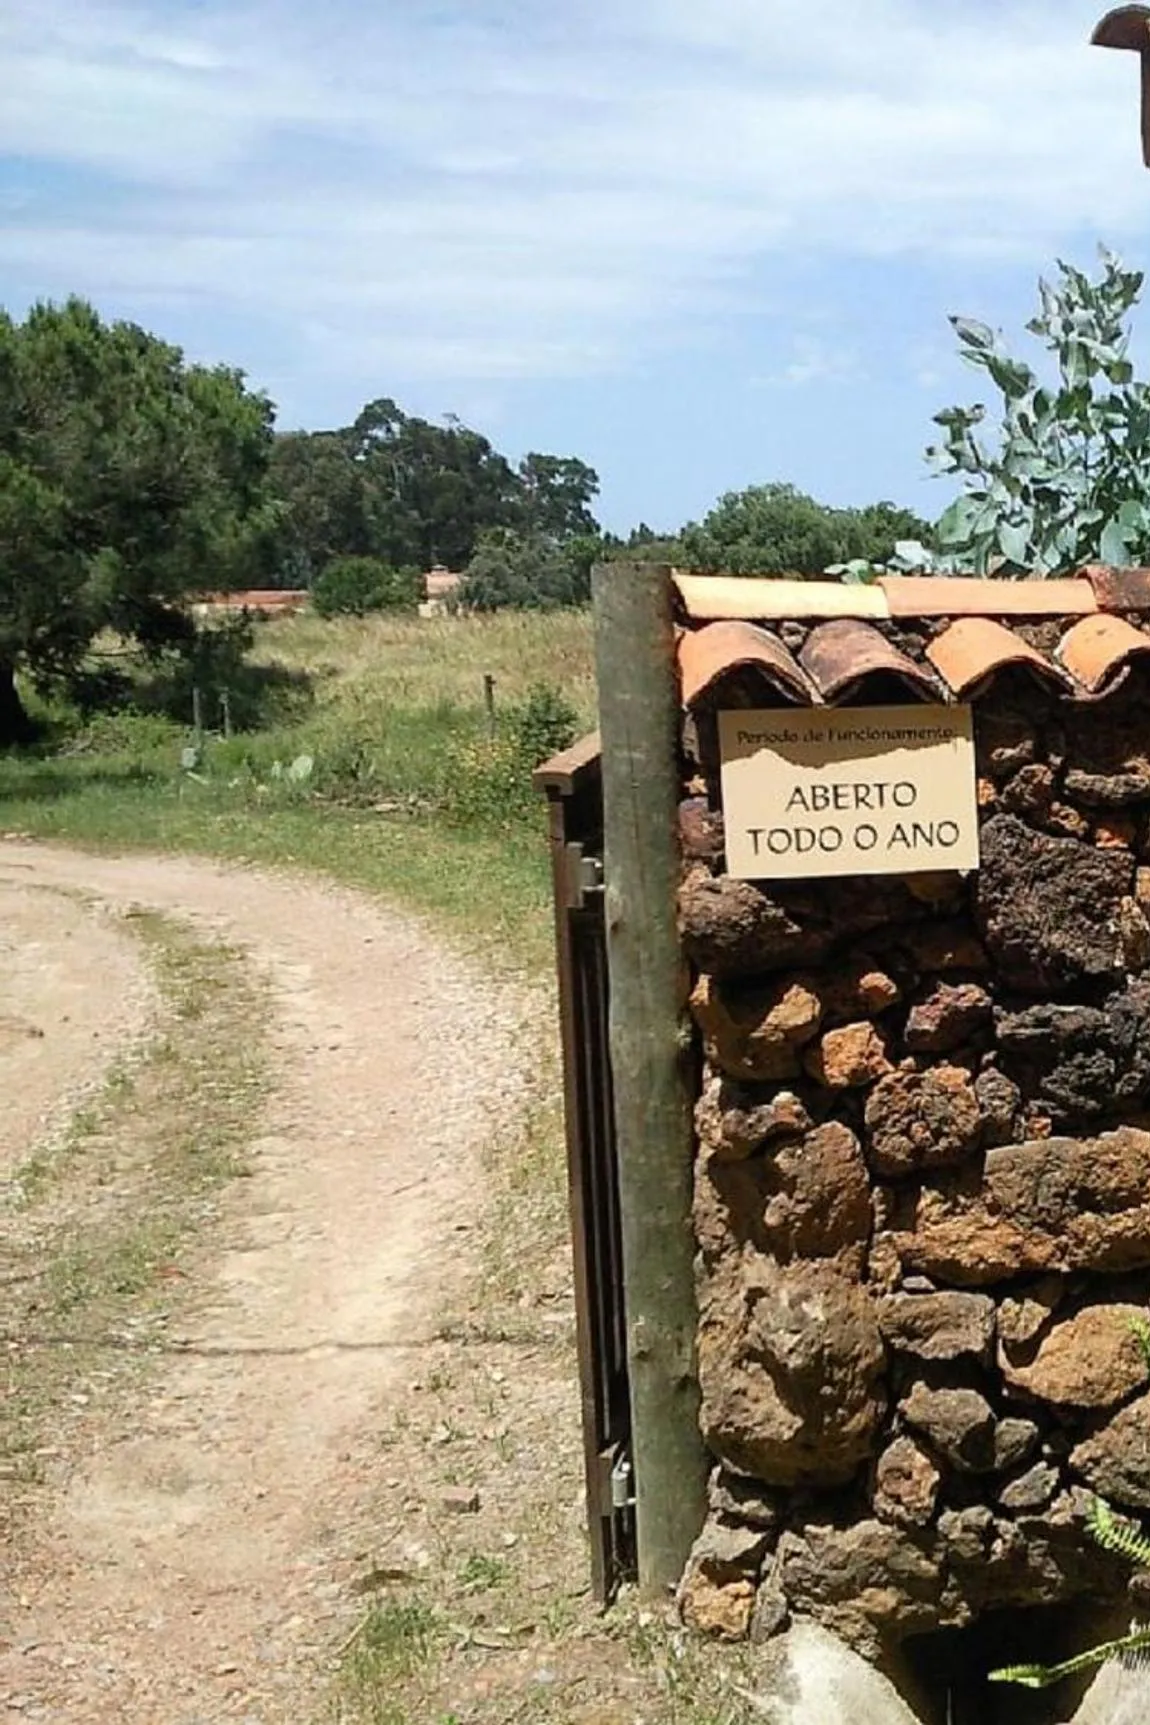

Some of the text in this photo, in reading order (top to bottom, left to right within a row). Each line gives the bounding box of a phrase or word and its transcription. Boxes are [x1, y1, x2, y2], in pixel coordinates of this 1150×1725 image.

[803, 728, 824, 742] de
[785, 781, 917, 812] ABERTO
[747, 821, 960, 855] TODO O ANO
